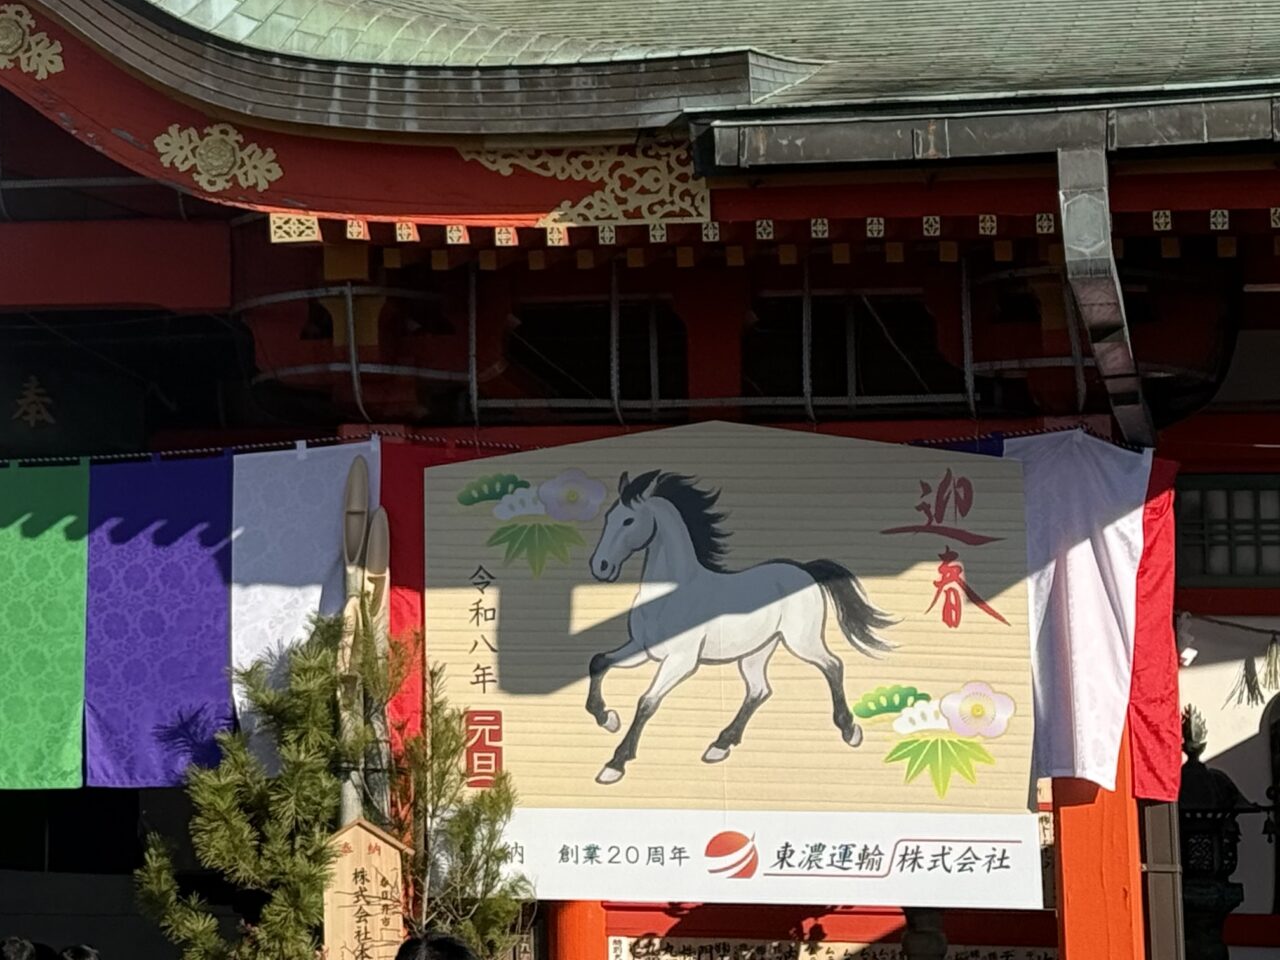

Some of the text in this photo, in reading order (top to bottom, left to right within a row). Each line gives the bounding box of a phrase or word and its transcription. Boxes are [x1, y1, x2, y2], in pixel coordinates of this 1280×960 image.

[12, 374, 56, 428] 奉
[879, 467, 1012, 629] 迎春
[466, 564, 503, 784] 令和八年 元旦
[558, 843, 690, 867] 創業20周年
[770, 841, 1012, 874] 東濃運輸株式会社
